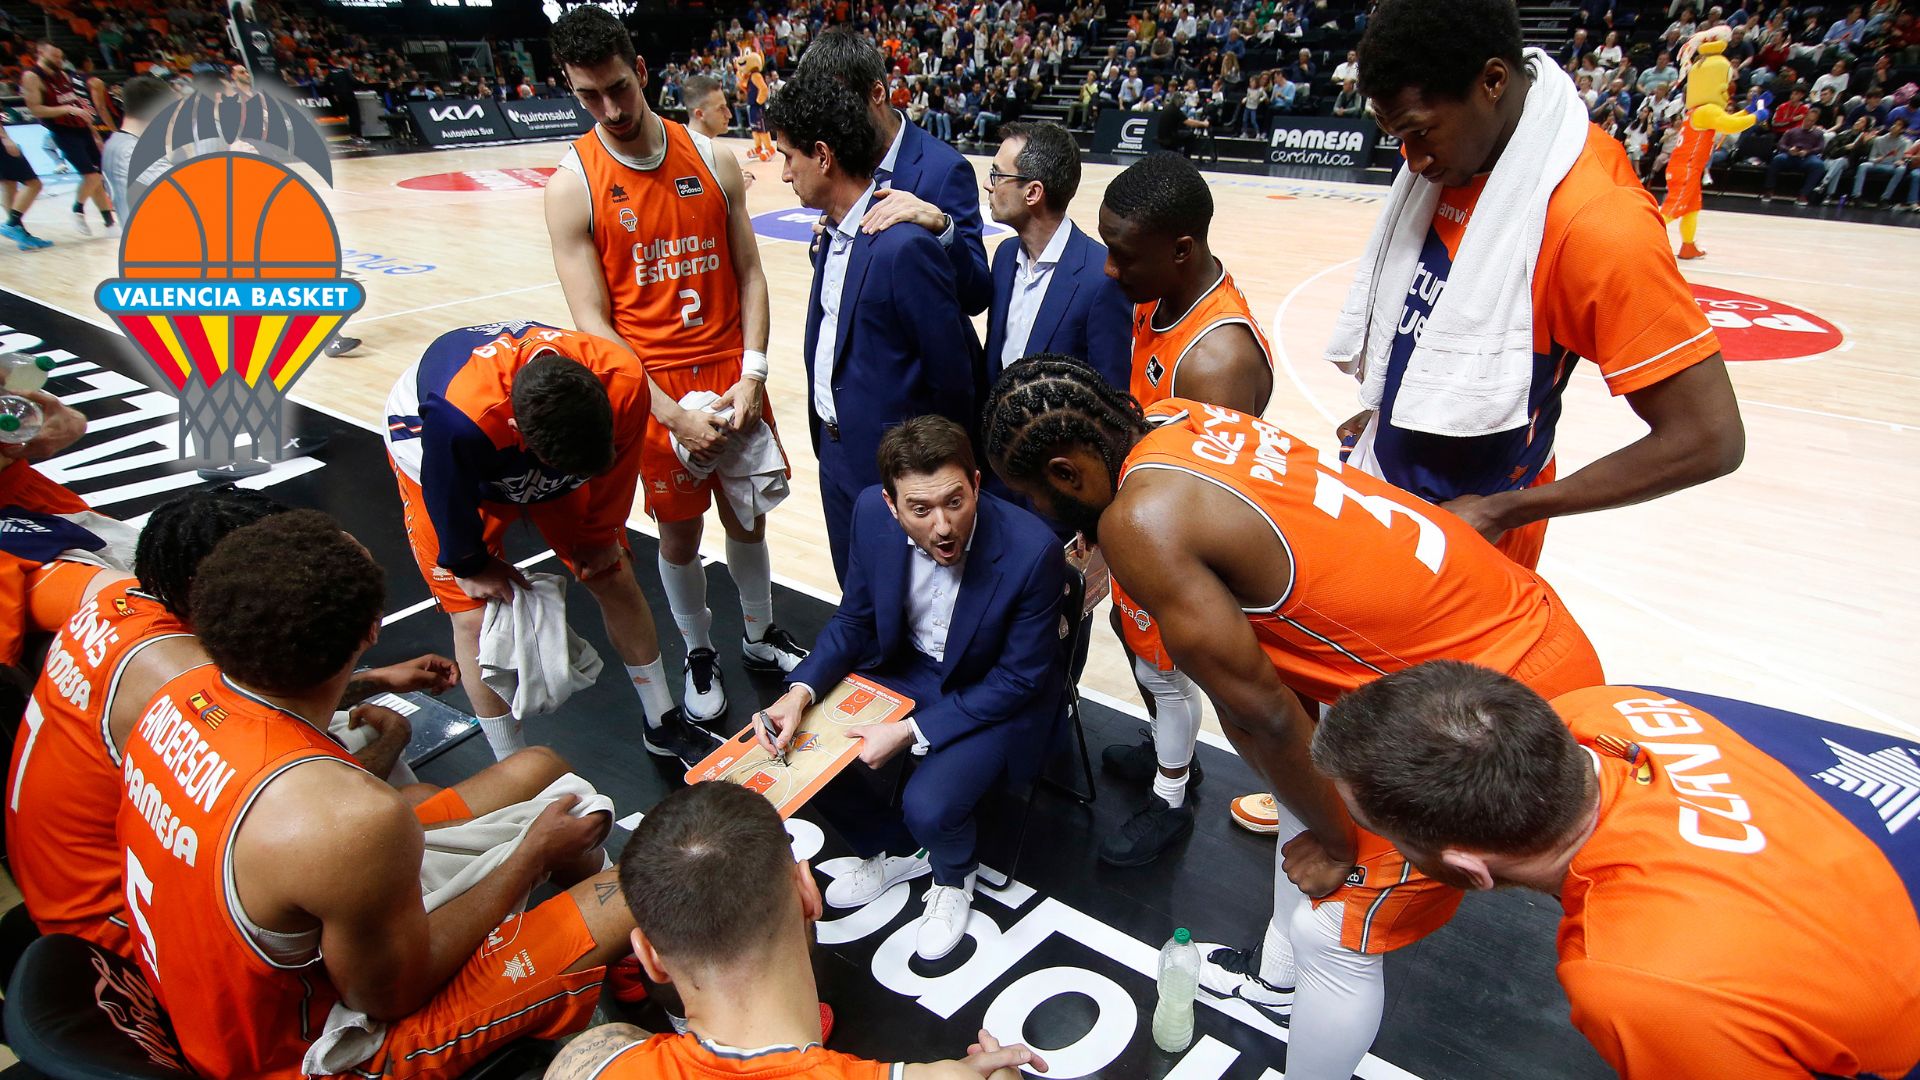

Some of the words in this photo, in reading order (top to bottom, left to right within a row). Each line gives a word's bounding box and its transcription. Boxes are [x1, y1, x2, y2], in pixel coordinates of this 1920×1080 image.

[429, 104, 485, 121] KIA
[441, 128, 480, 139] Autopista
[480, 127, 494, 136] Sur
[1271, 128, 1364, 151] PAMESA
[632, 236, 699, 264] Cultura
[701, 237, 715, 250] del
[635, 254, 720, 287] Esfuerzo
[678, 288, 704, 328] 2
[11, 694, 45, 814] 7
[139, 694, 236, 814] ANDERSON
[125, 752, 198, 868] PAMESA
[127, 845, 160, 983] 5
